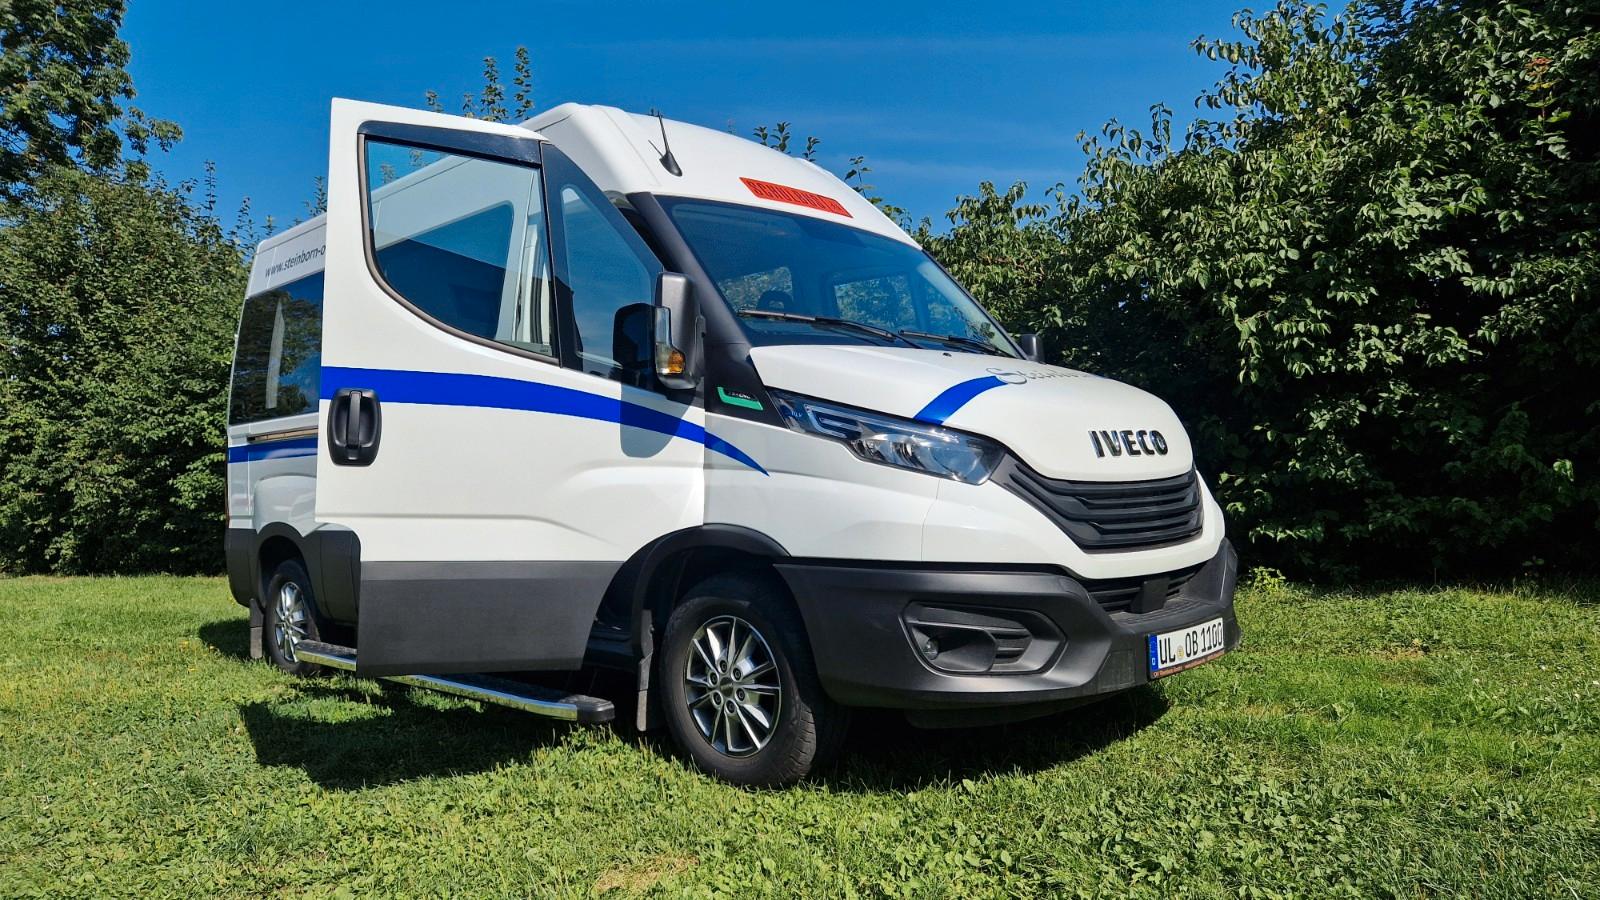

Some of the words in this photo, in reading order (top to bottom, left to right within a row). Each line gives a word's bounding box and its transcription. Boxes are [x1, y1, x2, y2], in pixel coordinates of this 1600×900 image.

[1088, 430, 1168, 458] IVECO
[1159, 637, 1176, 664] UL
[1185, 630, 1198, 657] OB
[1200, 622, 1223, 653] 1100
